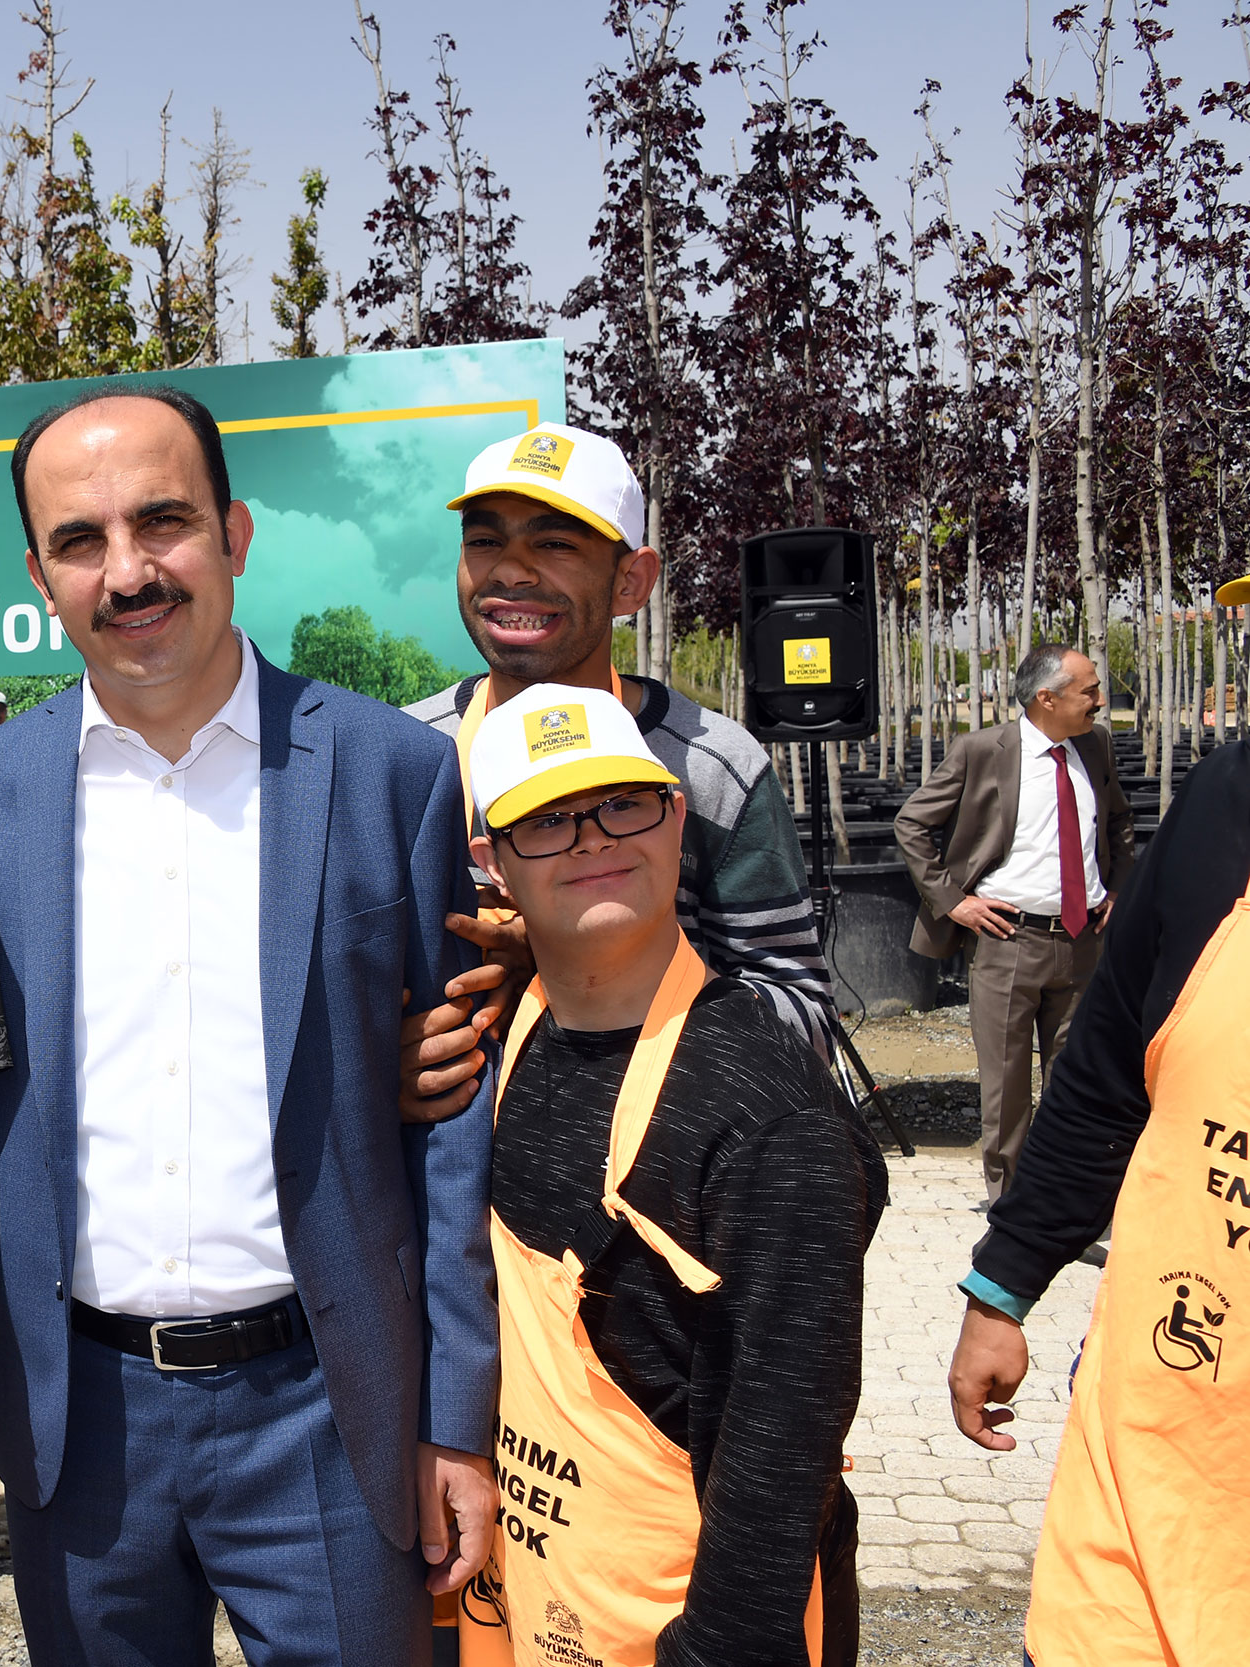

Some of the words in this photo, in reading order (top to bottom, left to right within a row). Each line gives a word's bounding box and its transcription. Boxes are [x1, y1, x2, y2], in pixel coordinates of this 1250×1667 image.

[527, 453, 551, 462] KONYA
[543, 729, 570, 739] KONYA
[1158, 1271, 1192, 1285] TARIMA
[1194, 1273, 1216, 1293] ENGEL
[1216, 1291, 1231, 1309] YOK
[495, 1457, 571, 1527] NGEL
[548, 1631, 584, 1651] KONYA
